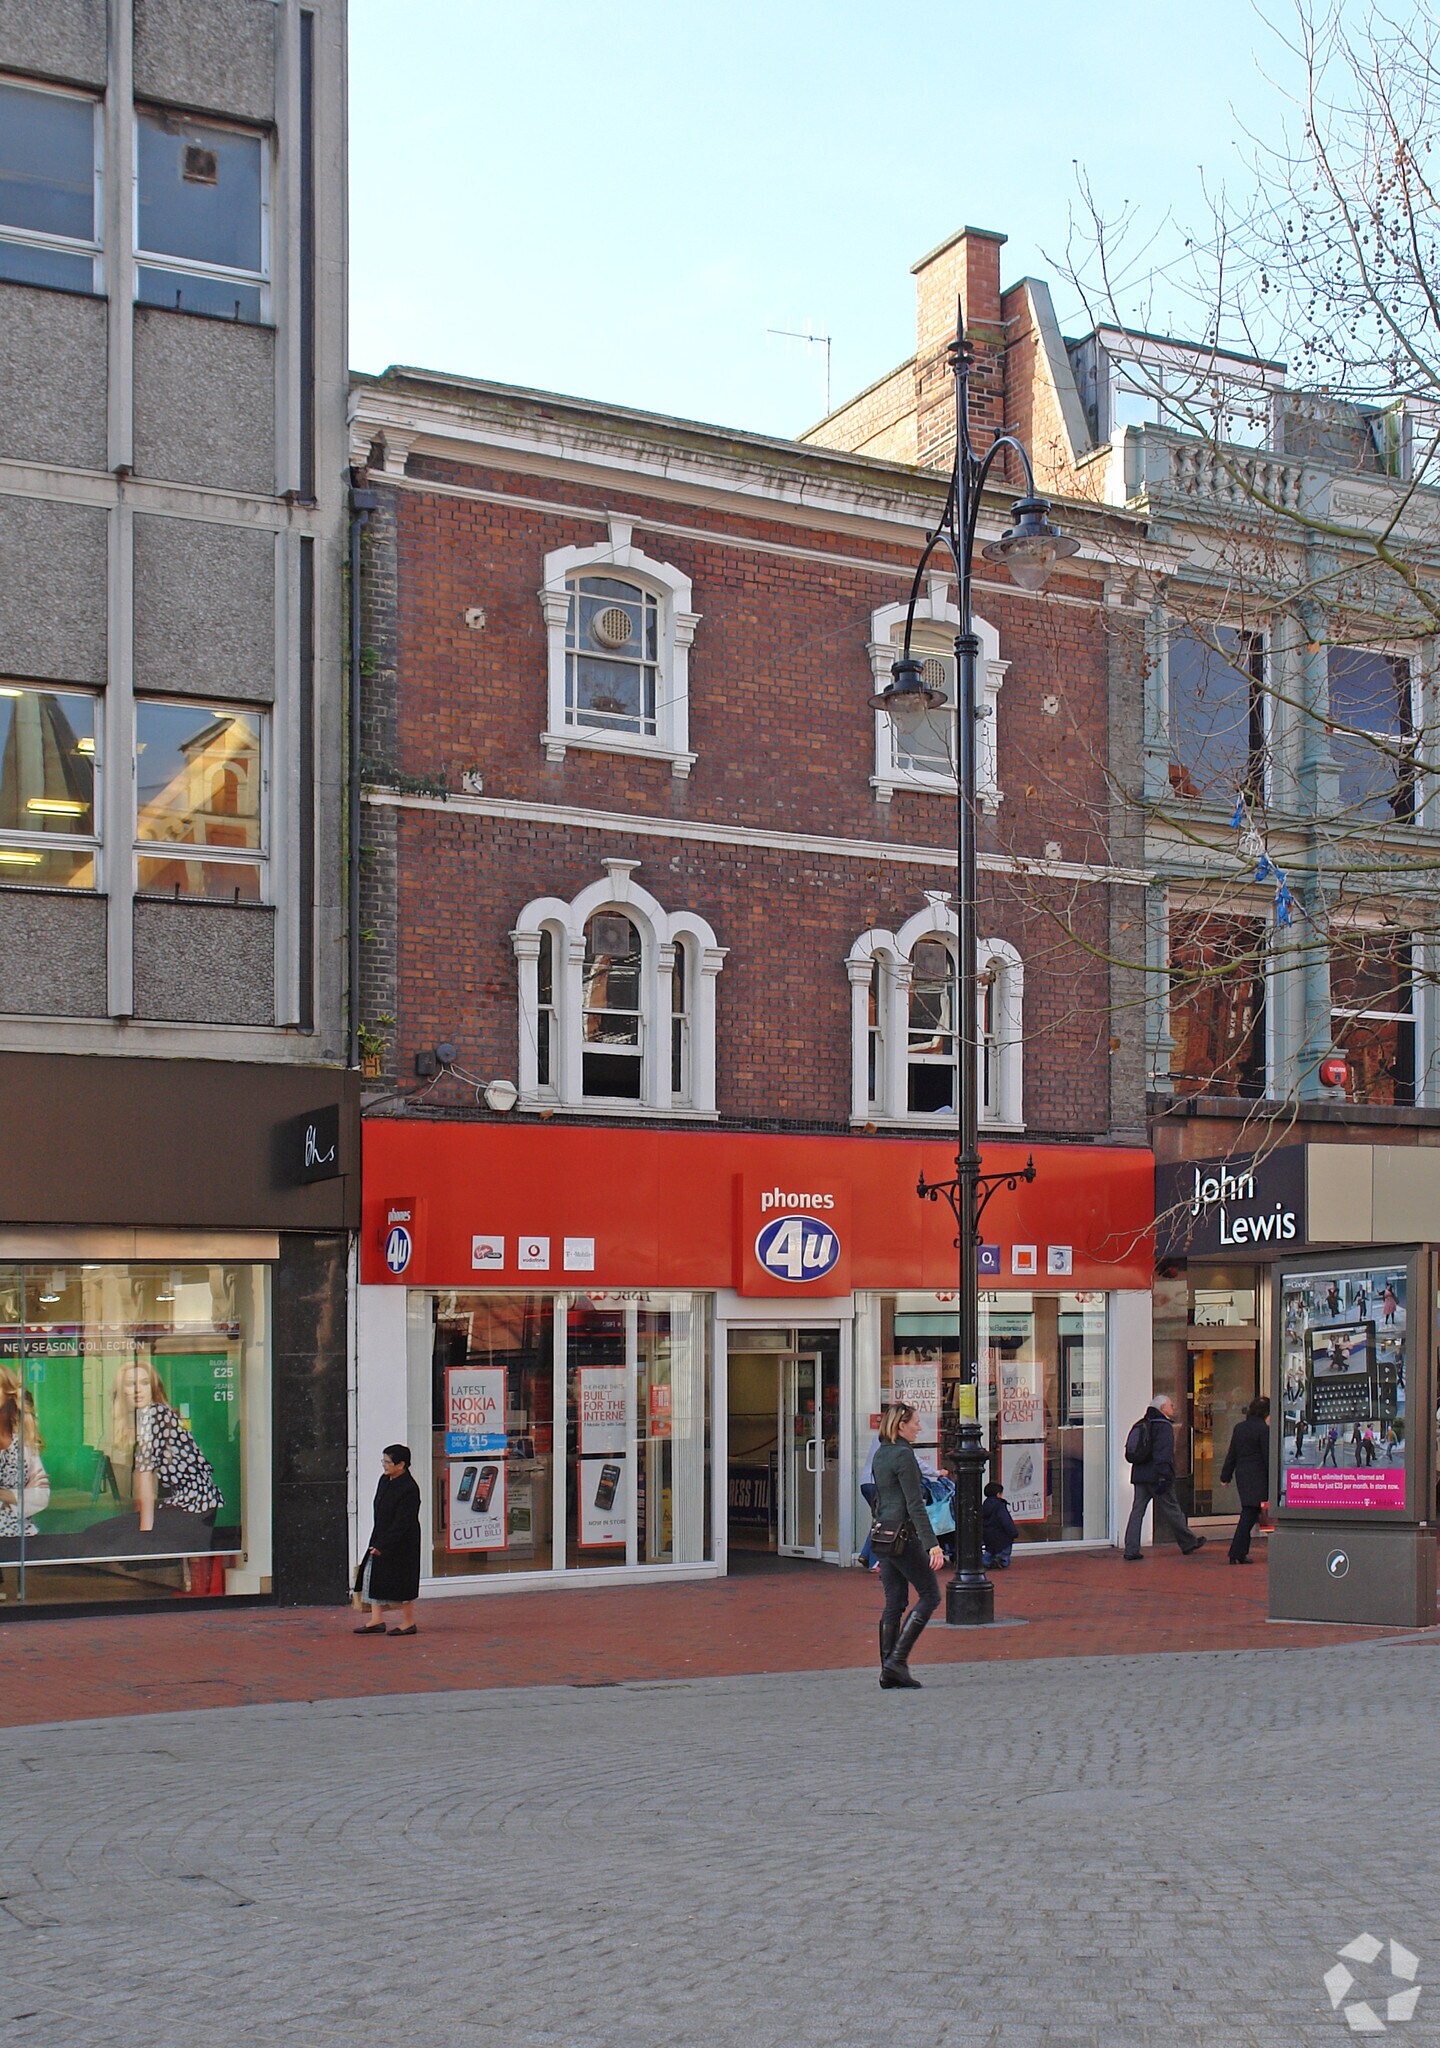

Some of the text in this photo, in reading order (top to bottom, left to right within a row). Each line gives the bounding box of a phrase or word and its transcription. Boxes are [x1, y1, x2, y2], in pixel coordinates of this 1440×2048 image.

[1191, 1166, 1254, 1216] John
[761, 1187, 835, 1212] phones
[388, 1208, 411, 1225] phones
[1220, 1203, 1296, 1245] Lewis
[387, 1230, 408, 1270] 4u
[766, 1220, 834, 1277] 4u
[1053, 1251, 1065, 1270] 3
[1291, 1280, 1311, 1290] Google
[31, 1341, 76, 1352] SEASON
[78, 1340, 146, 1352] COLLECTION
[213, 1367, 234, 1378] £25
[894, 1379, 914, 1388] SAVE
[1002, 1376, 1027, 1386] UP TO
[213, 1391, 234, 1402] £15
[451, 1385, 487, 1396] LATEST
[583, 1390, 612, 1401] BUILT
[894, 1389, 936, 1400] UPGRADE
[1003, 1386, 1030, 1399] £200
[451, 1397, 496, 1411] NOKIA
[583, 1400, 626, 1411] FOR THE
[894, 1400, 935, 1412] TDAY
[1002, 1399, 1040, 1411] INSTANT
[451, 1411, 486, 1426] 5800
[583, 1410, 626, 1421] INTERNE
[1003, 1410, 1034, 1423] CASH
[468, 1434, 488, 1447] £15
[453, 1525, 482, 1541] CUT
